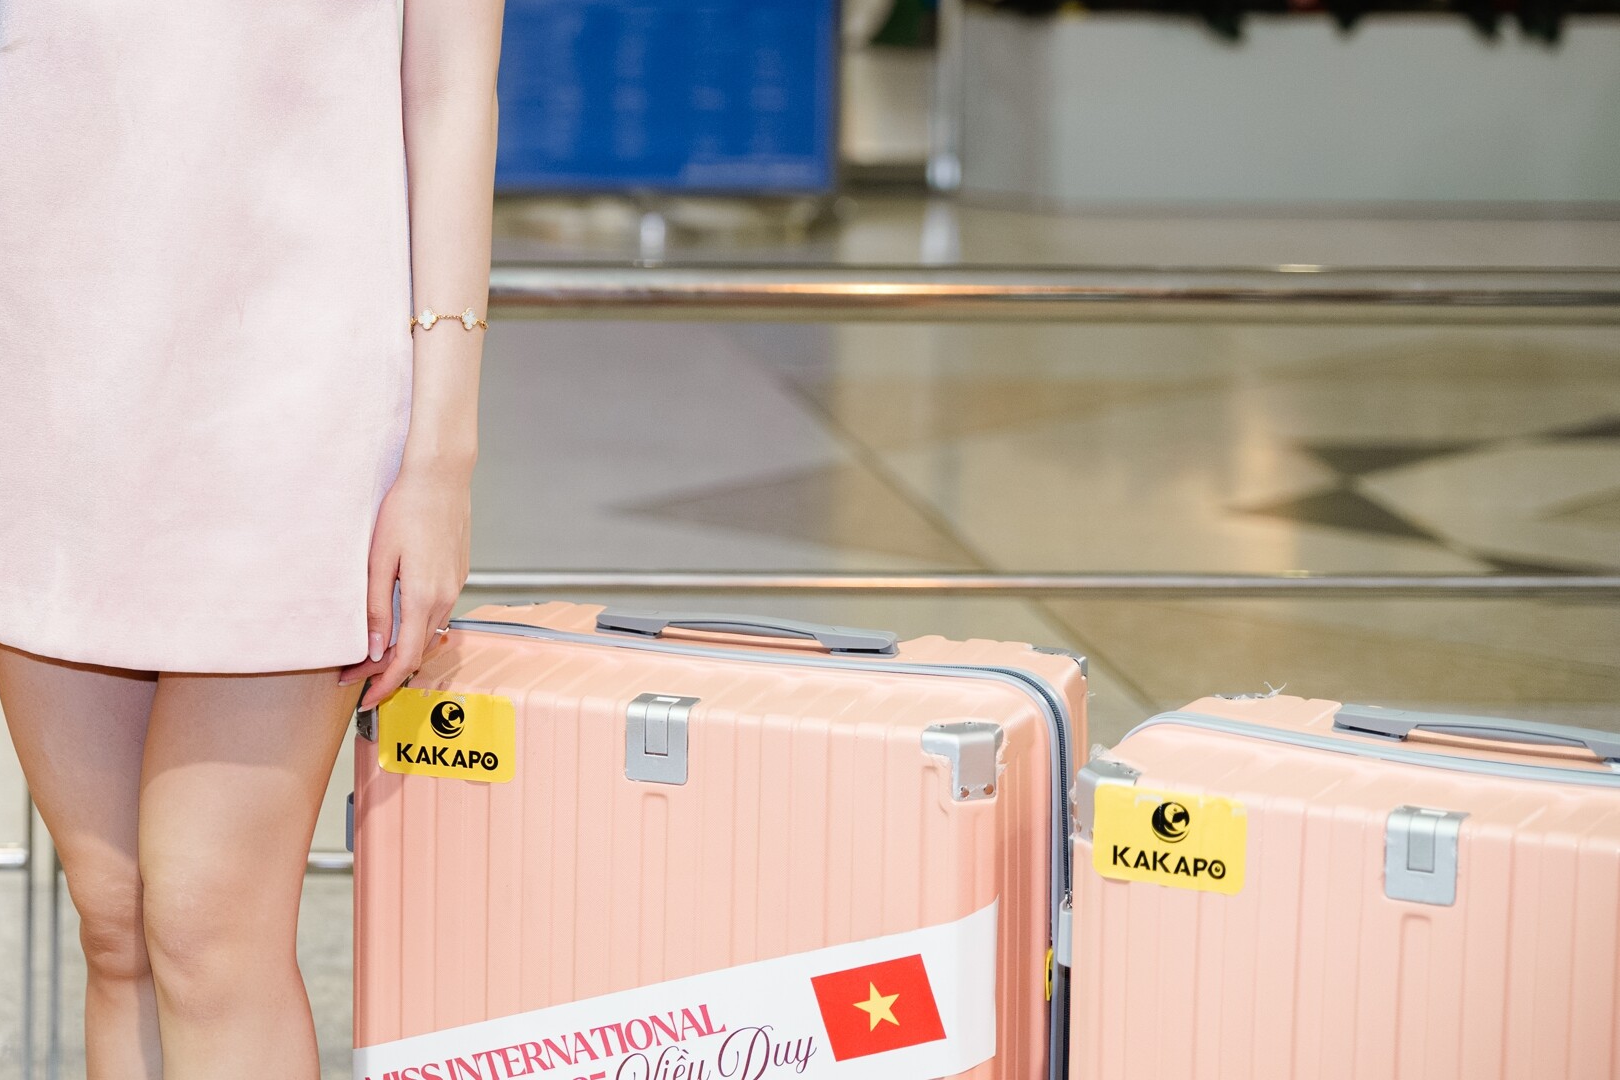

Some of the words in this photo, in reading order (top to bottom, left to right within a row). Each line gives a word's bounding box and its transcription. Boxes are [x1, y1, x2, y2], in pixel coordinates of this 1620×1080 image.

[396, 742, 498, 771] KAKAPO
[1113, 844, 1226, 880] KAKAPO
[717, 1024, 817, 1080] Duy
